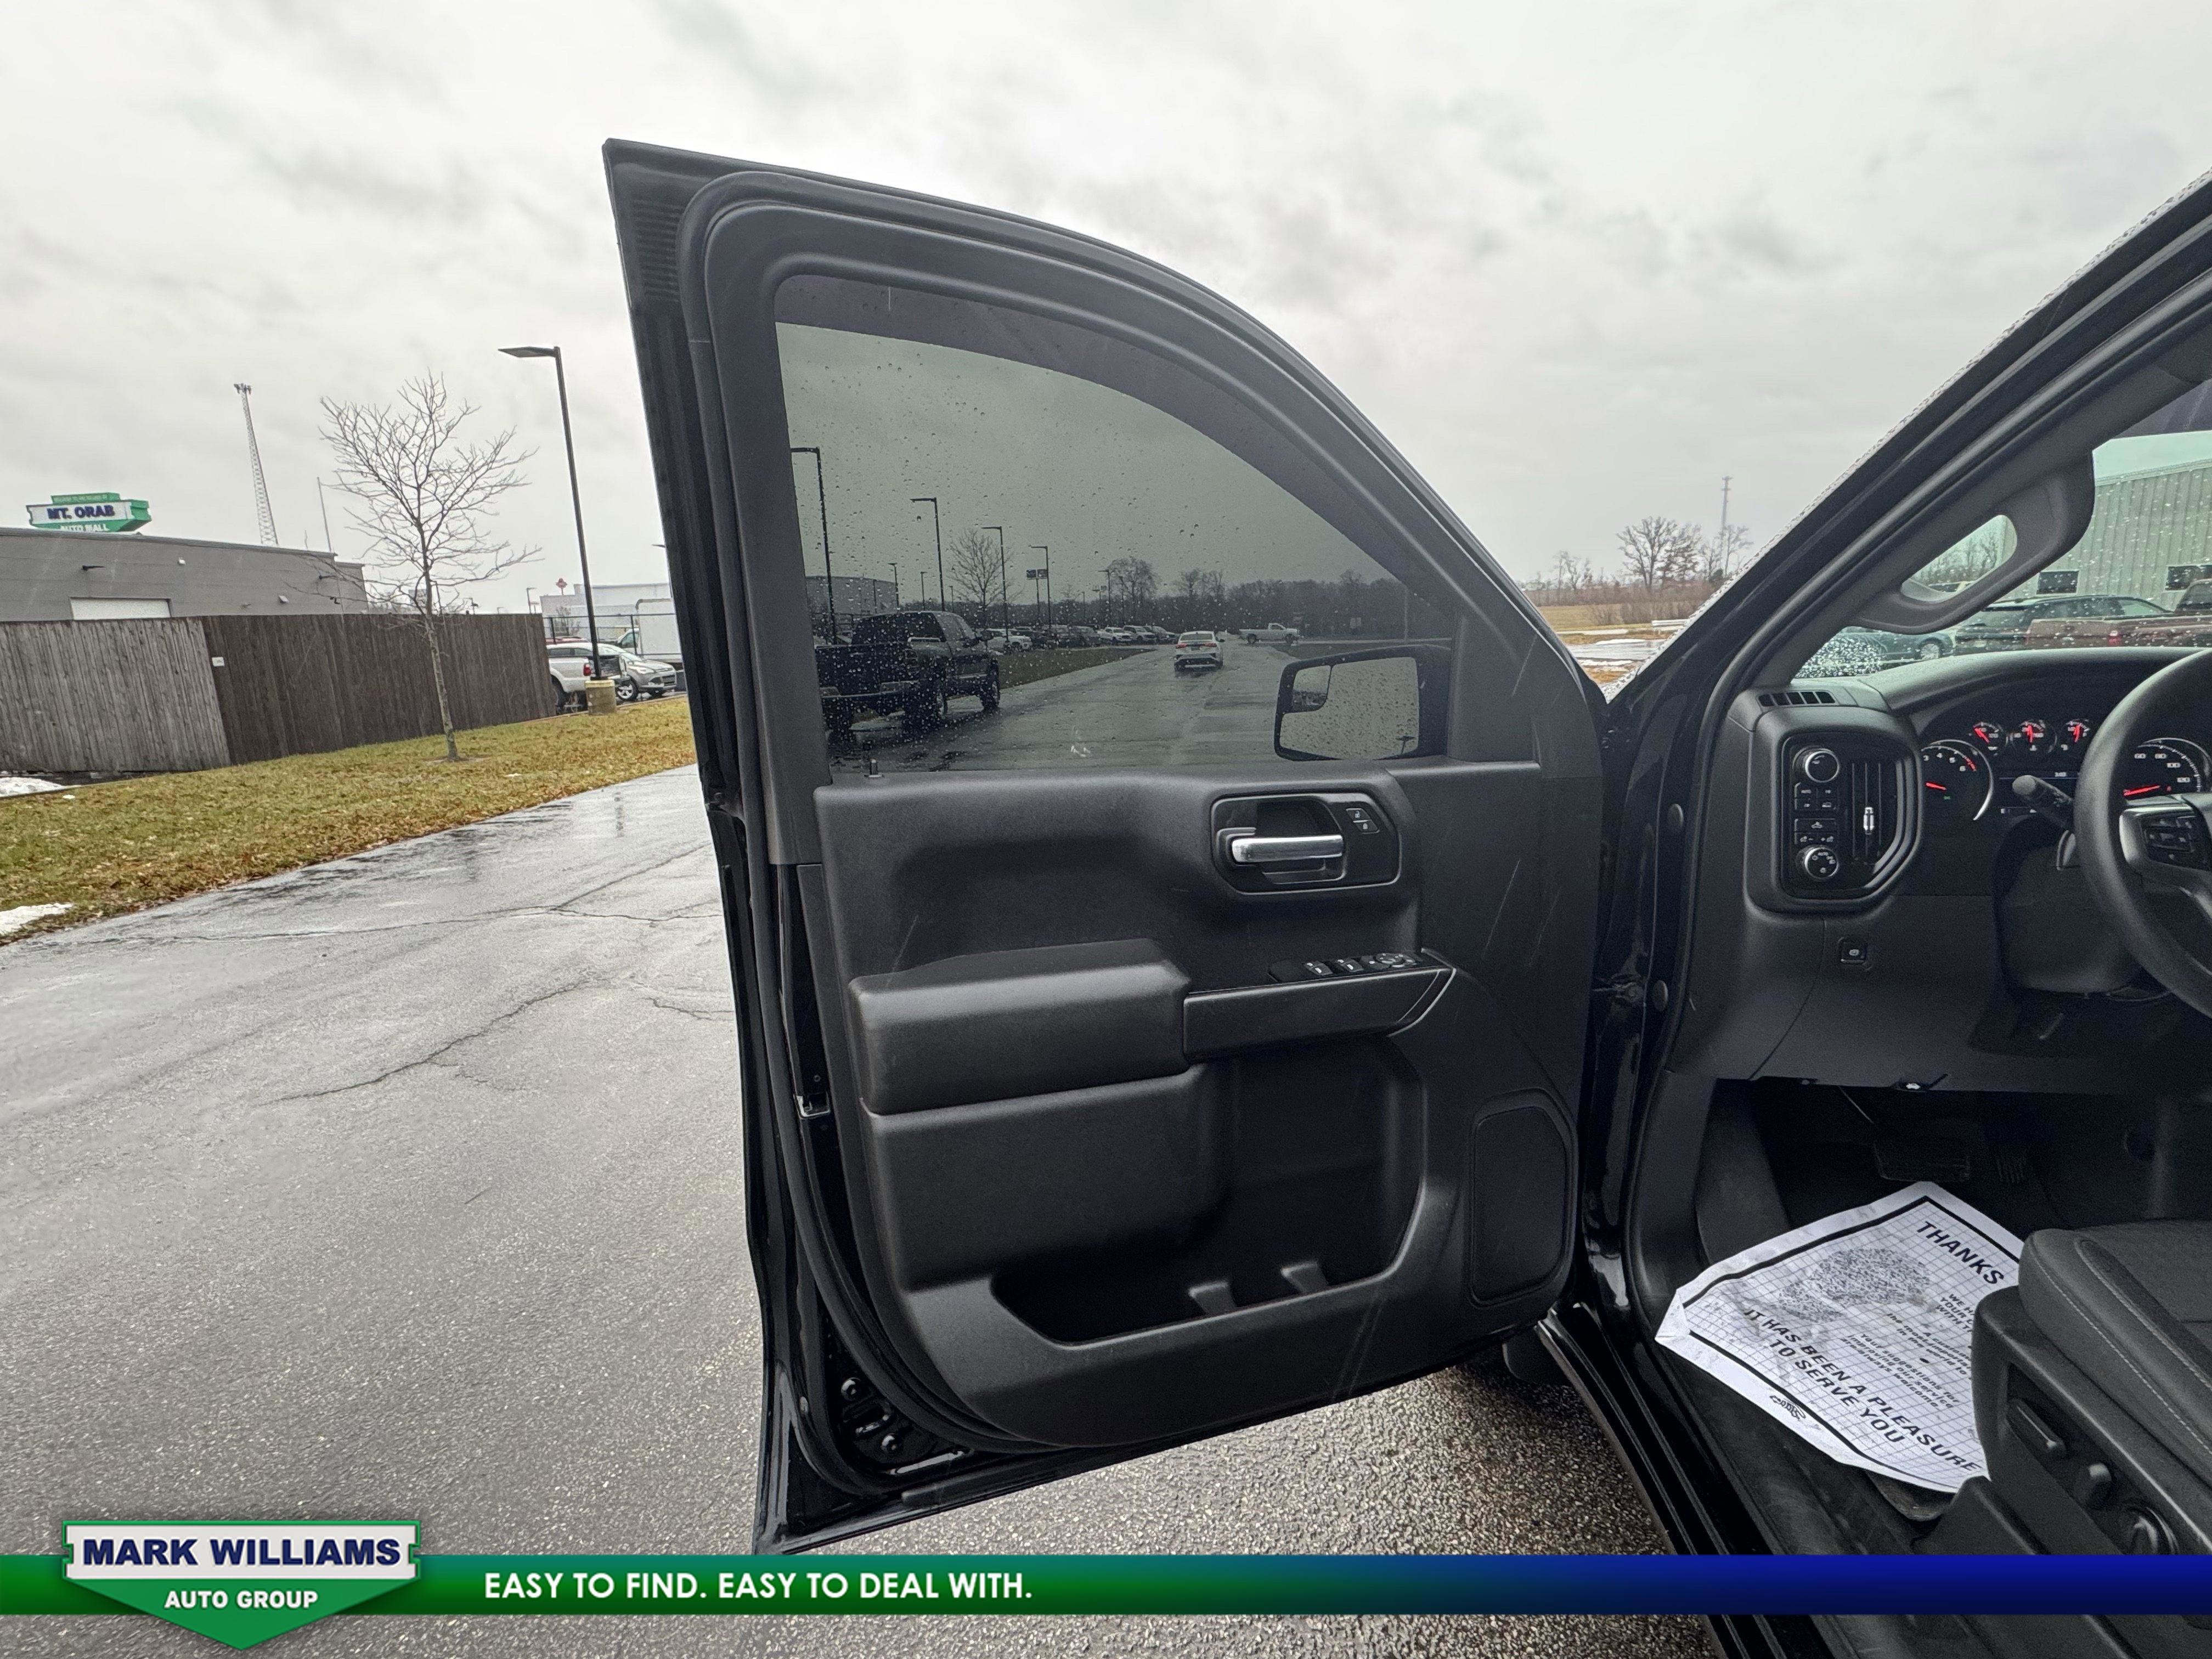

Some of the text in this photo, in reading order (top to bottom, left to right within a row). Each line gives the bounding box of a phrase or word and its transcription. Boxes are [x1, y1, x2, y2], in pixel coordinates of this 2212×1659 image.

[47, 505, 115, 520] MT. ORAB
[1916, 1220, 2005, 1285] THANKS
[1935, 1305, 1964, 1325] WITH
[1940, 1297, 1967, 1318] YOUR
[1949, 1294, 1965, 1307] WE
[1847, 1334, 1955, 1409] improving our service
[1857, 1350, 1893, 1372] always
[1908, 1337, 1925, 1348] the
[1926, 1348, 1956, 1366] world
[1955, 1367, 1967, 1375] to
[1743, 1309, 1766, 1321] IT
[1762, 1319, 1802, 1343] HAS
[1800, 1345, 1852, 1381] BEEN
[1848, 1385, 1867, 1395] A
[1867, 1396, 1983, 1471] PLEASURE
[1769, 1339, 1906, 1443] TO SERVE YOU
[1882, 1350, 1943, 1391] suggestions
[1943, 1391, 1960, 1403] for
